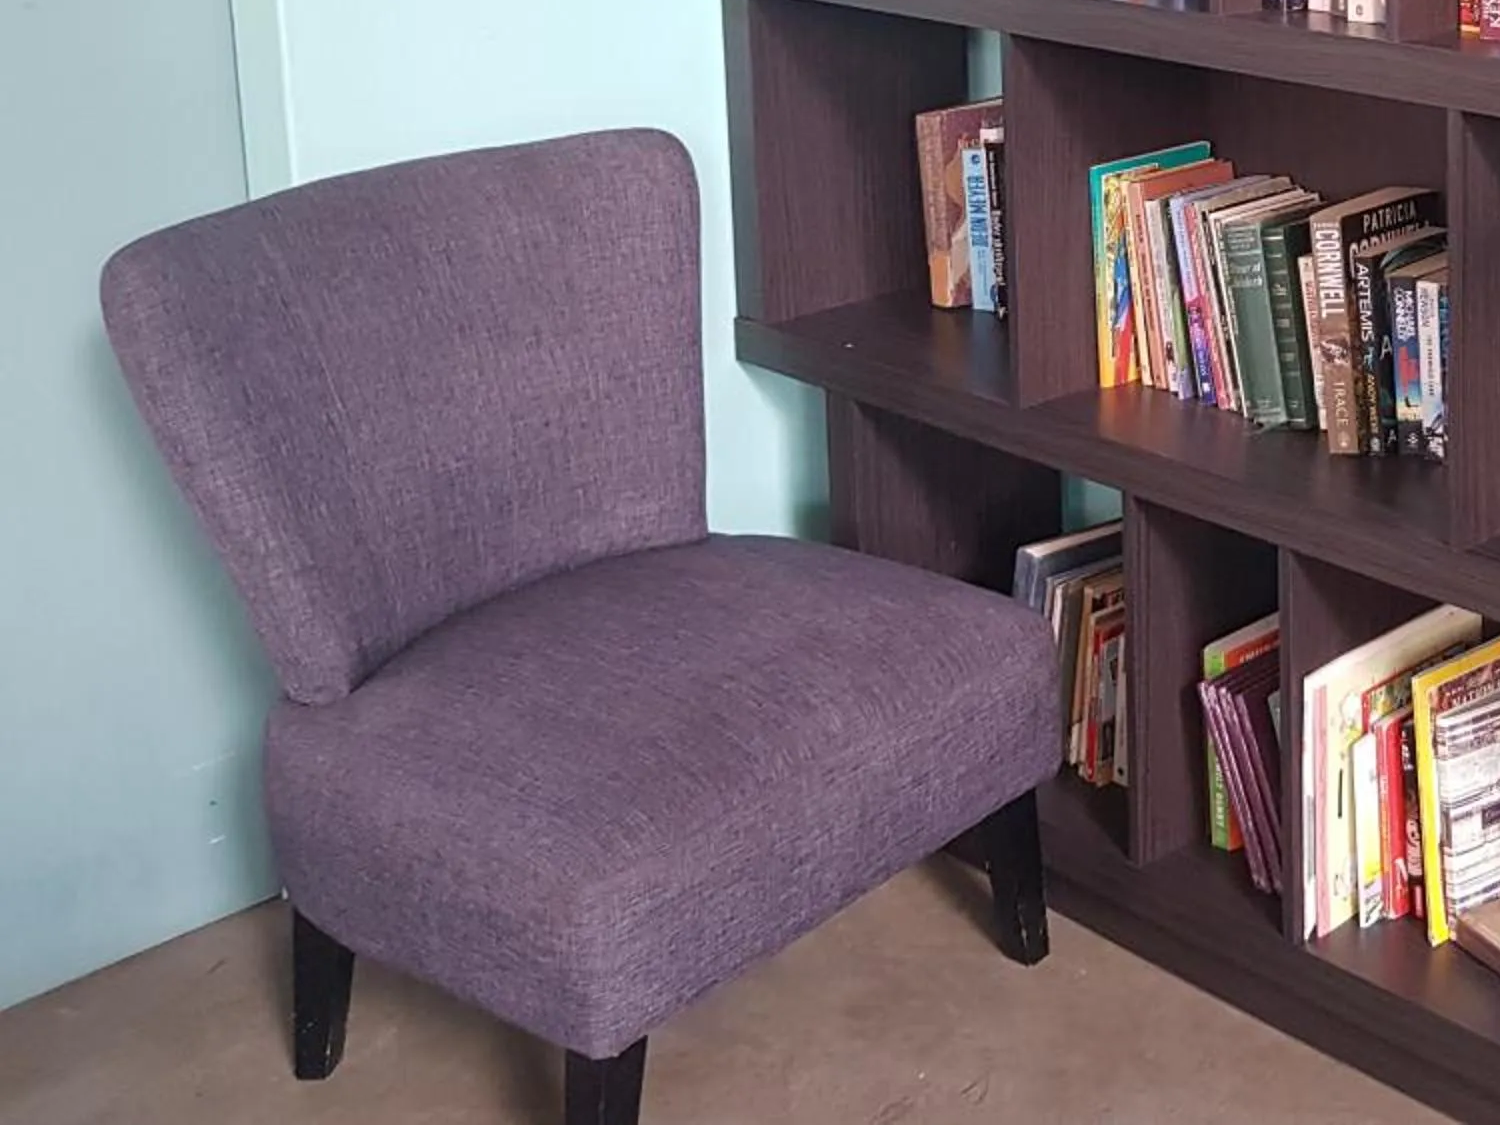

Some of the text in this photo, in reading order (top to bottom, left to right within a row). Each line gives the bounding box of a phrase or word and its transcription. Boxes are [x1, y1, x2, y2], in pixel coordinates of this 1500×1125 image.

[967, 176, 987, 214] MEYER
[1363, 199, 1418, 234] PATRICIA
[1315, 230, 1345, 319] CORNWELL
[1355, 263, 1374, 342] ARTEMIS
[1332, 382, 1350, 426] TRACE
